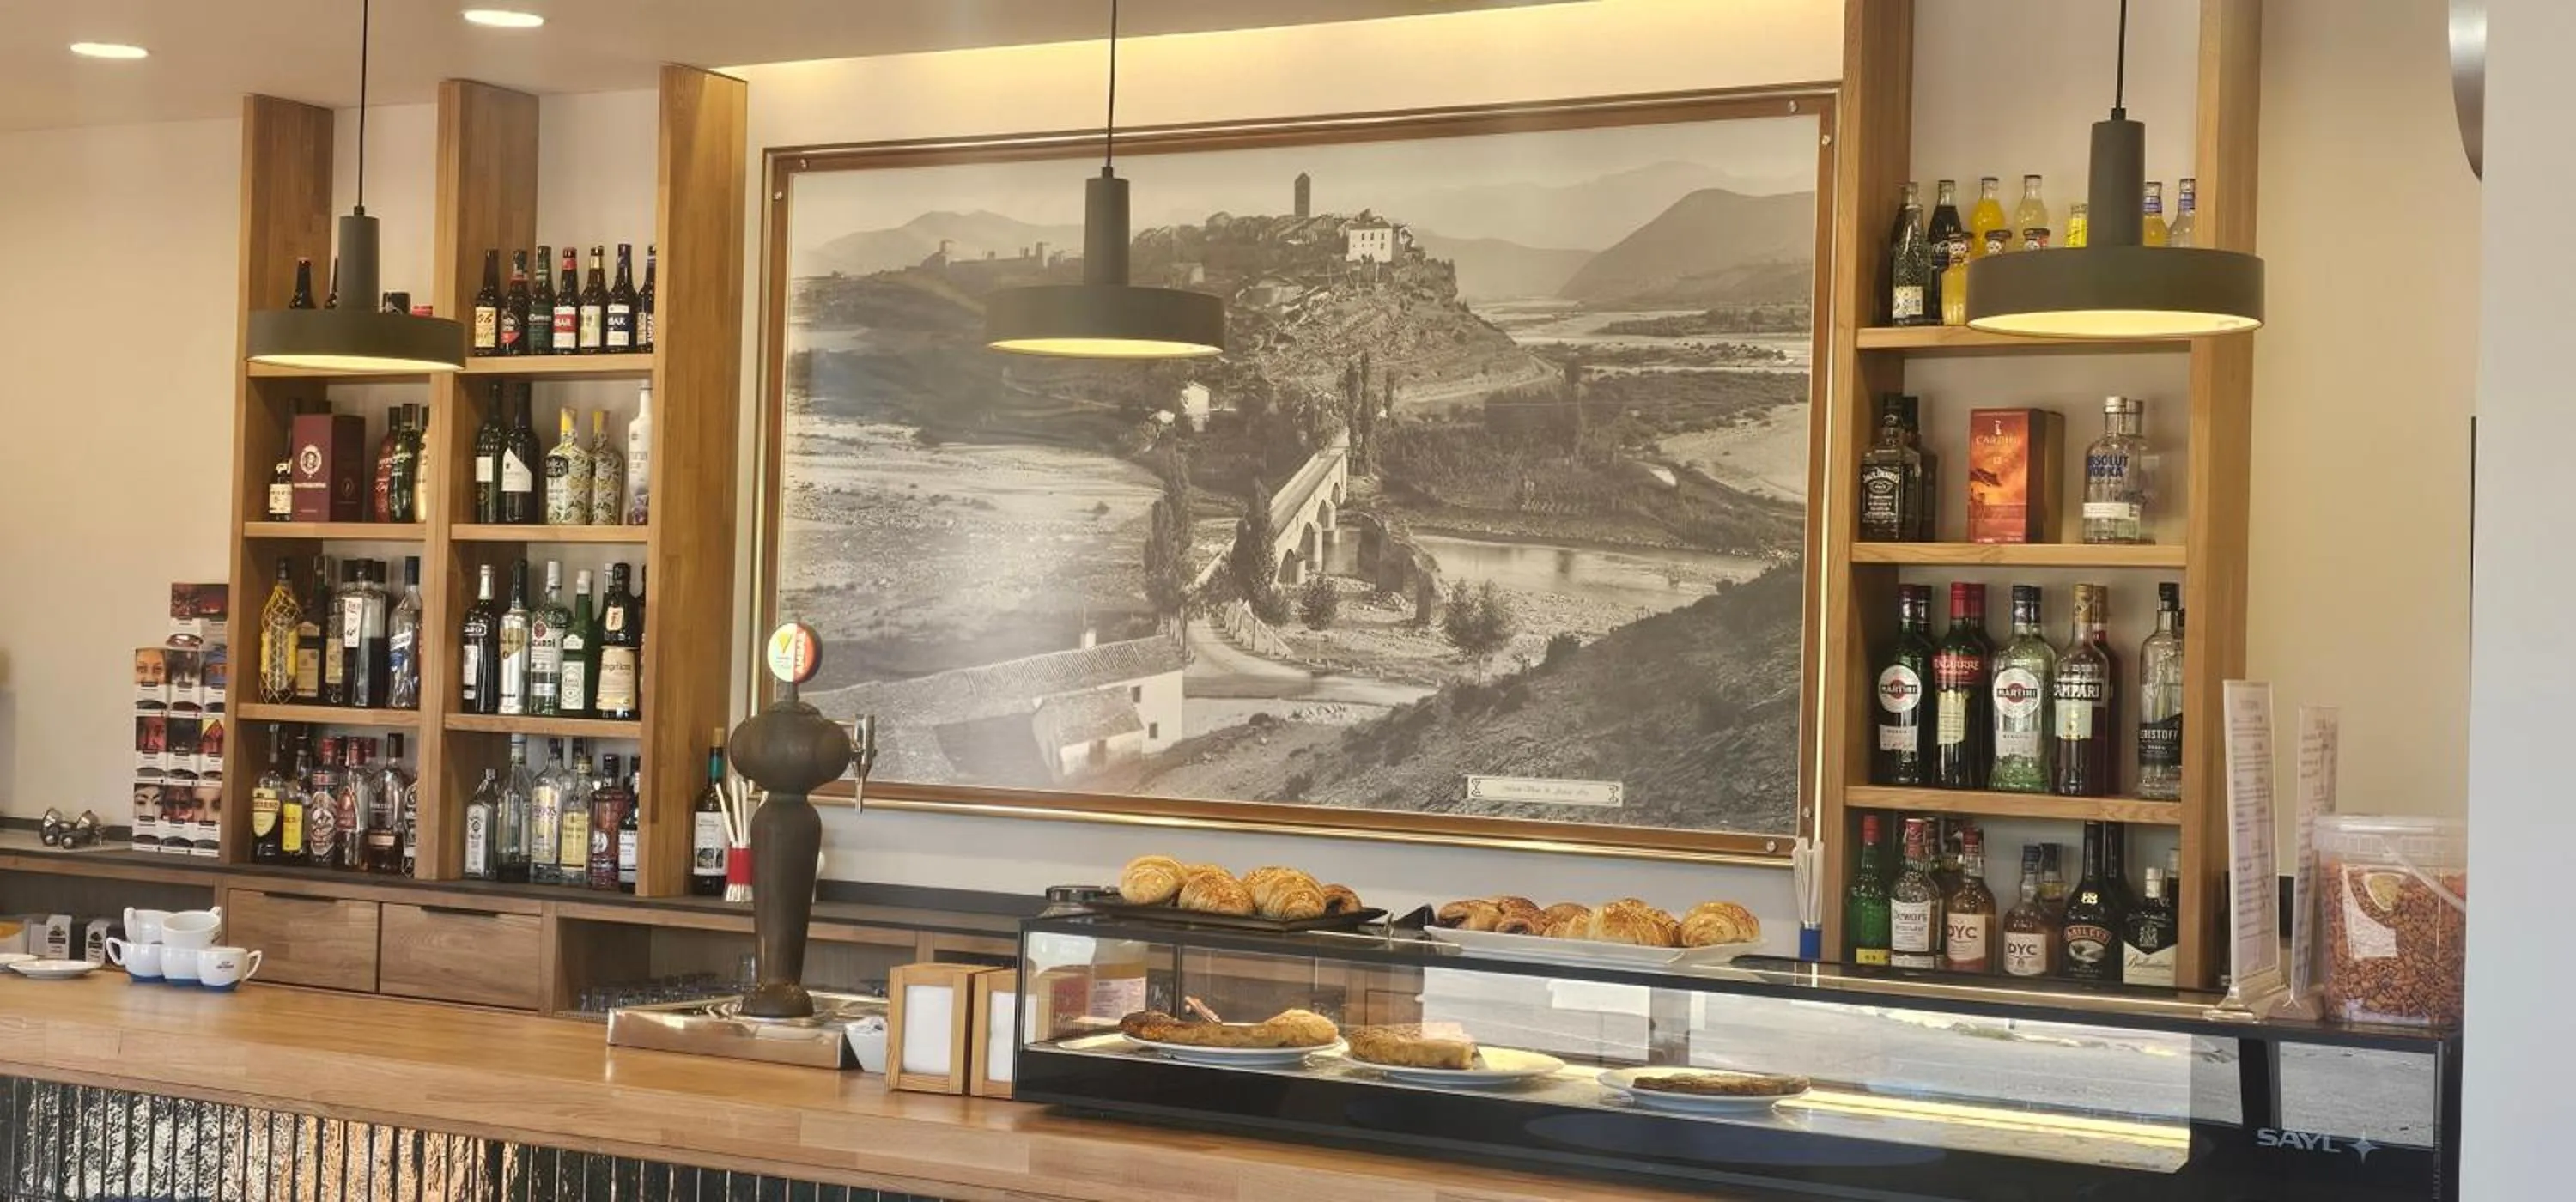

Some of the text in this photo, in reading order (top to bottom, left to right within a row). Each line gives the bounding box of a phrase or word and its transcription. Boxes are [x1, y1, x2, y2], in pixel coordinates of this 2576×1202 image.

[1998, 689, 2038, 698] MARTINI
[2008, 943, 2037, 956] DYC
[2257, 1127, 2342, 1153] SAYL
